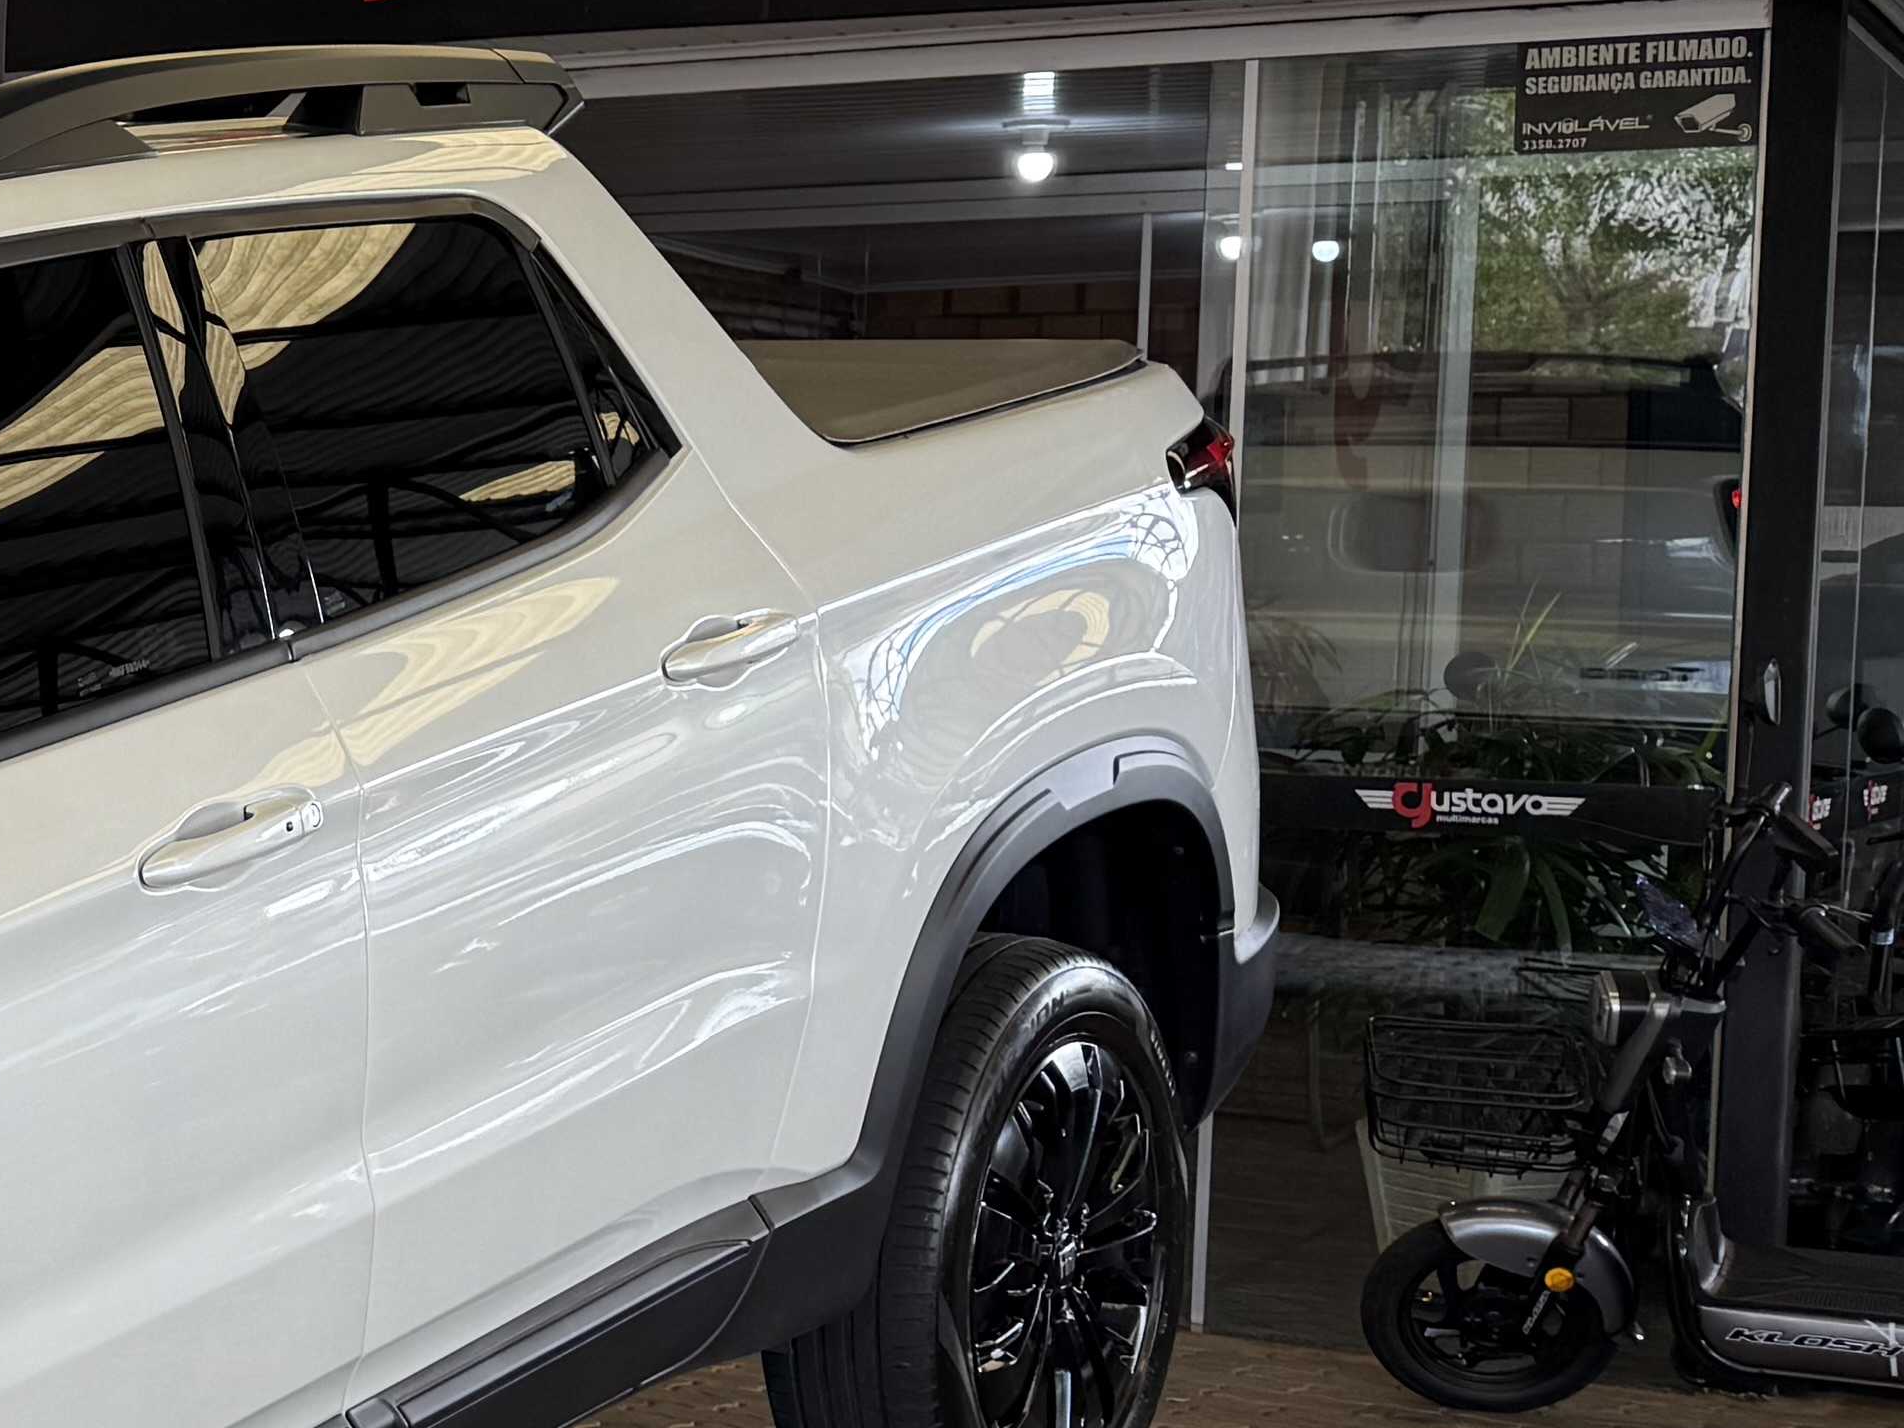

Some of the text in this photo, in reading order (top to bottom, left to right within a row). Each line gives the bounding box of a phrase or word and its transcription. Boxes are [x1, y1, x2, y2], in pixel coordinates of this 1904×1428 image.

[1525, 36, 1753, 70] AMBIENTE FILMADO.
[1525, 66, 1752, 96] SEGURANÇA GARANTIDA.
[1392, 782, 1548, 828] gustavo
